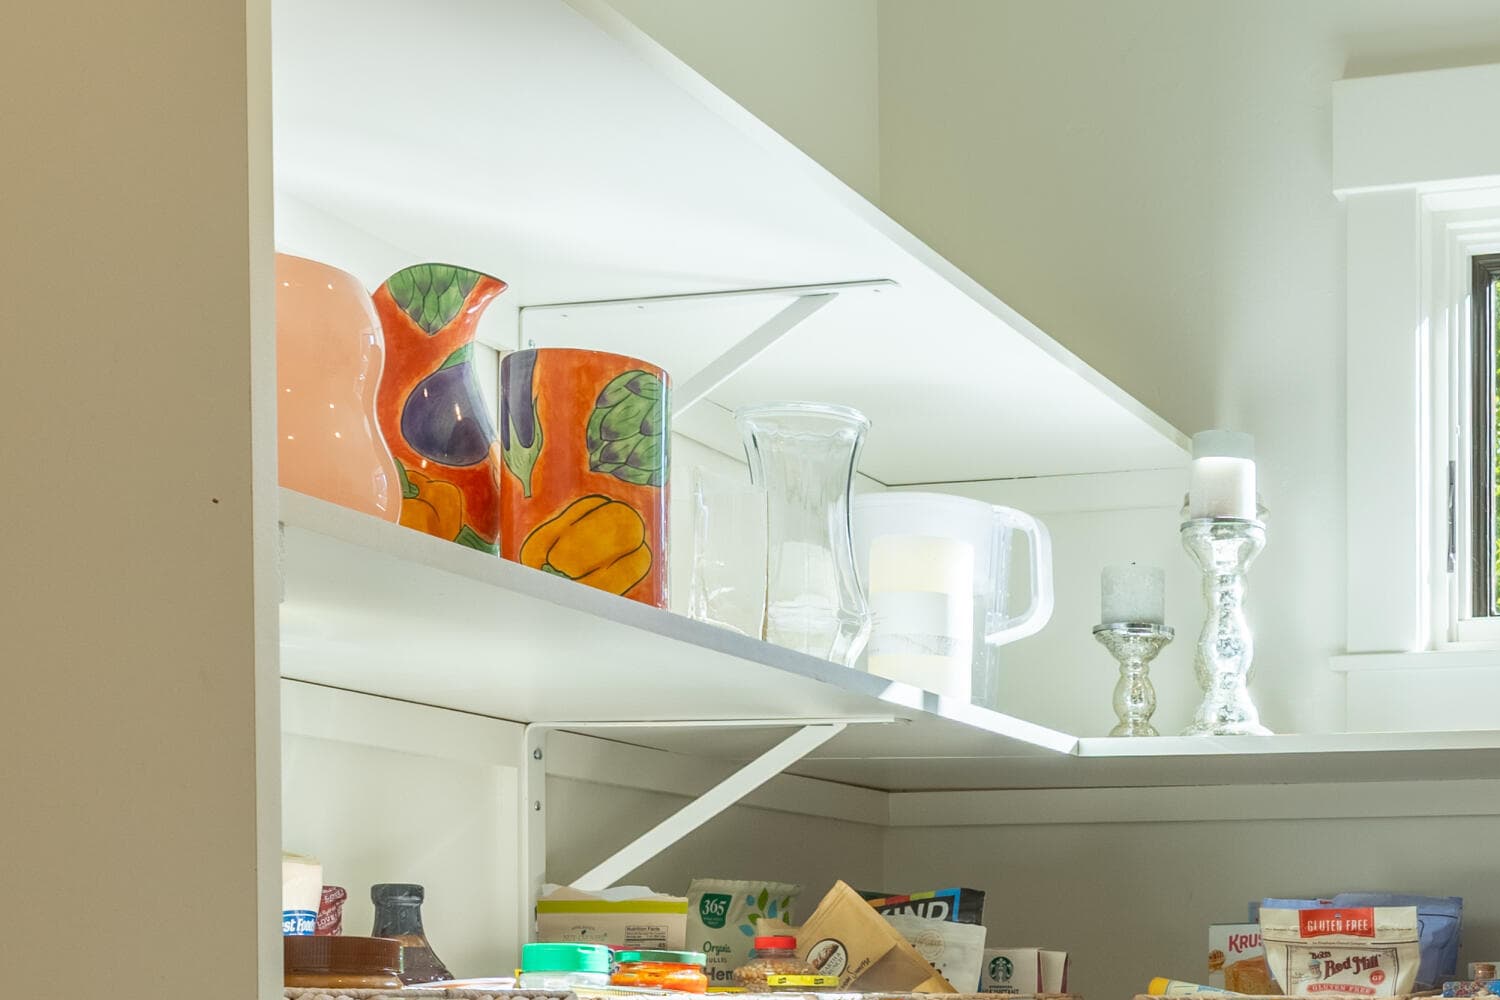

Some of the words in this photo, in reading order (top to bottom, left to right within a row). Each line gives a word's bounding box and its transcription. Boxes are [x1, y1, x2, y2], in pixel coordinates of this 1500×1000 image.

[702, 898, 727, 916] 365
[283, 919, 296, 933] st
[1307, 919, 1343, 932] GLUTEN
[1346, 919, 1369, 931] FREE
[1228, 932, 1263, 953] KRUS
[1324, 956, 1352, 980] Red
[1352, 953, 1380, 975] Mill
